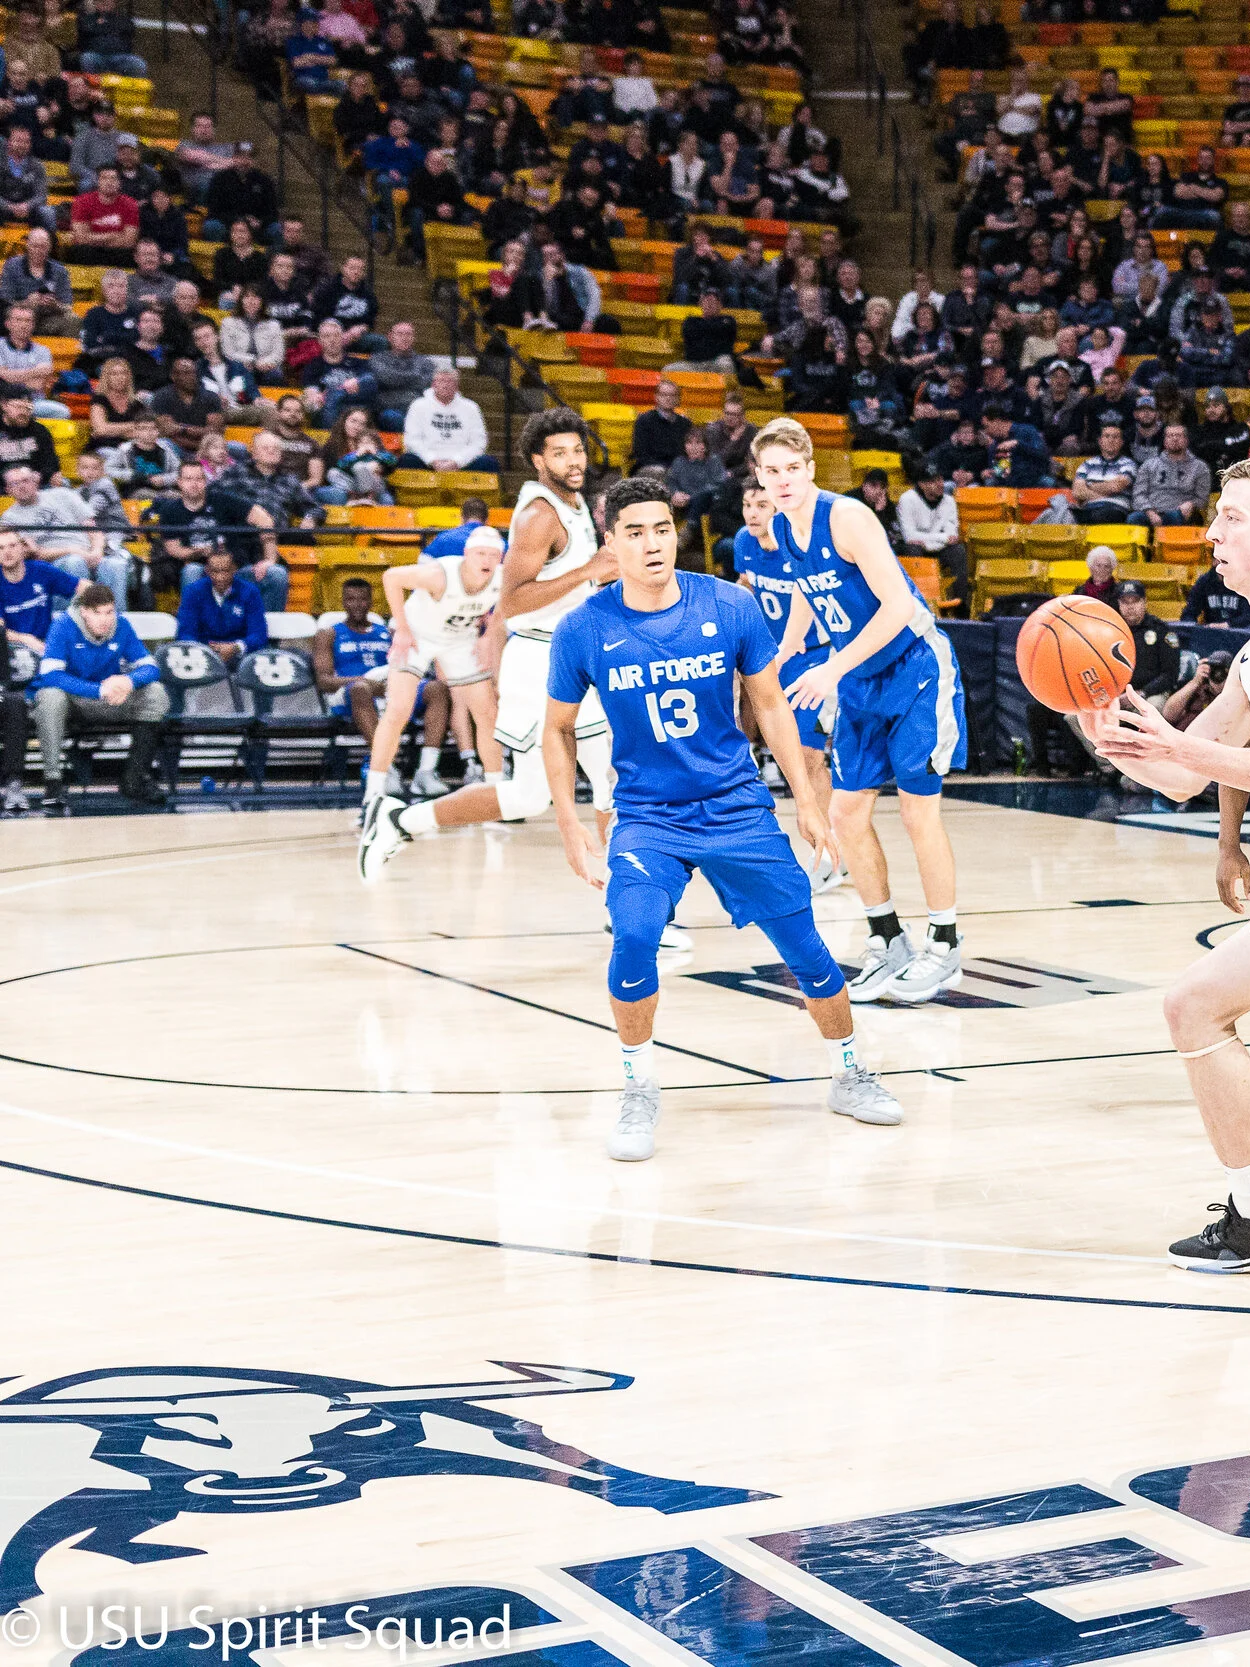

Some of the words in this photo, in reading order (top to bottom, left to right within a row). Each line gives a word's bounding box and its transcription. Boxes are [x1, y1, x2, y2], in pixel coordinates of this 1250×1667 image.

[760, 591, 783, 620] 0
[608, 664, 646, 691] AIR
[649, 651, 726, 685] FORCE
[645, 688, 699, 743] 13
